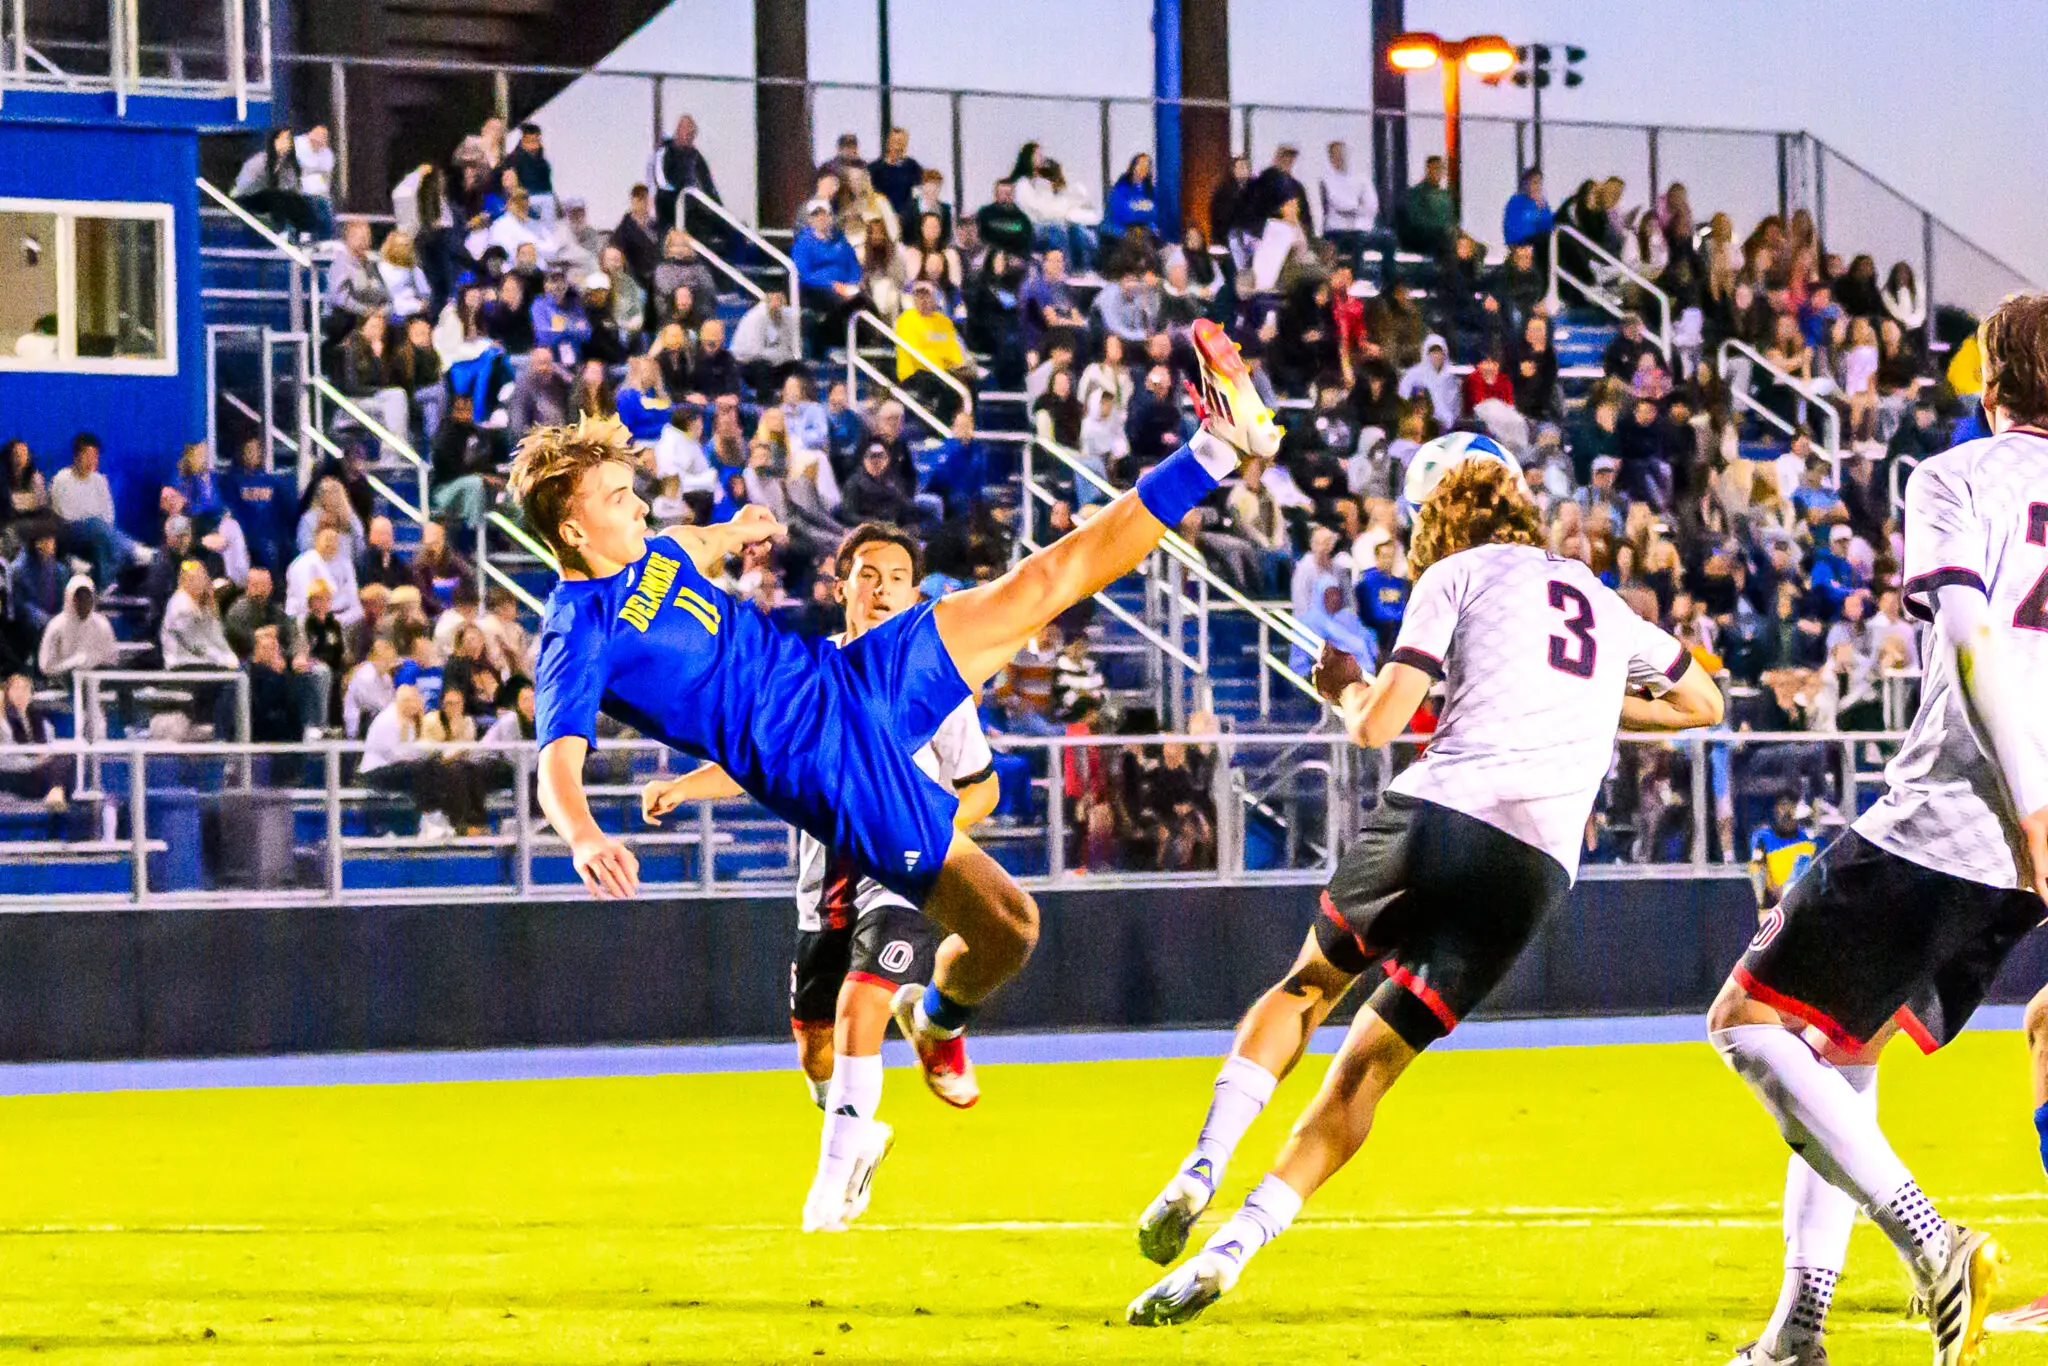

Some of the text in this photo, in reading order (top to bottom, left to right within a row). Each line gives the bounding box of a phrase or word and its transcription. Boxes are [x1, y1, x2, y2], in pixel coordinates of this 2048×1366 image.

[618, 551, 681, 633] DELAWARE
[673, 586, 722, 636] 11
[1547, 580, 1597, 679] 3
